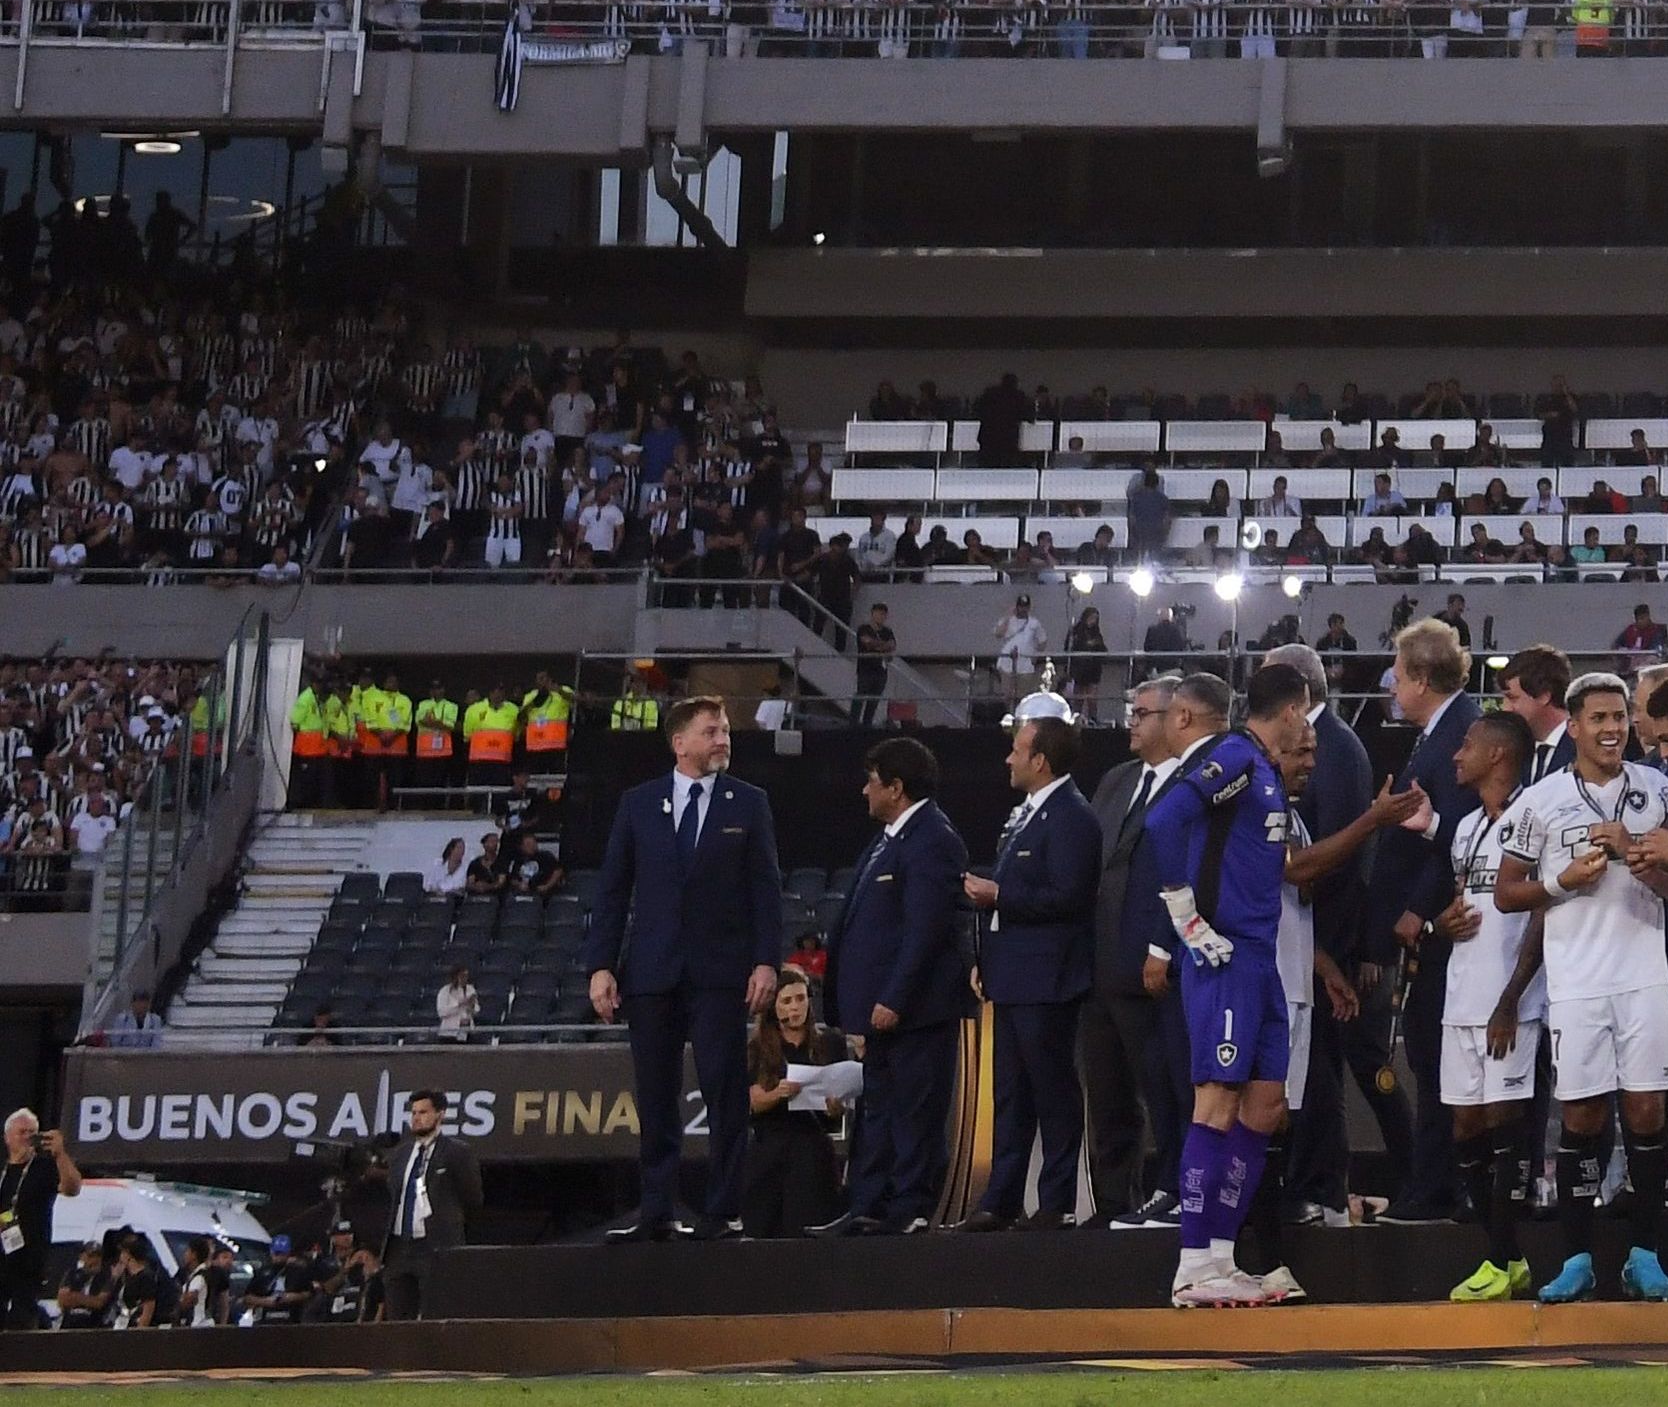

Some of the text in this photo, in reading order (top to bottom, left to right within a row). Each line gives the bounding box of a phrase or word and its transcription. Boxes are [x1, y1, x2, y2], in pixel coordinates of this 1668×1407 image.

[1213, 773, 1250, 805] Centrum
[1224, 1008, 1233, 1041] 1
[1552, 1028, 1562, 1061] 7
[77, 1091, 318, 1144] BUENOS
[513, 1090, 642, 1136] FINA
